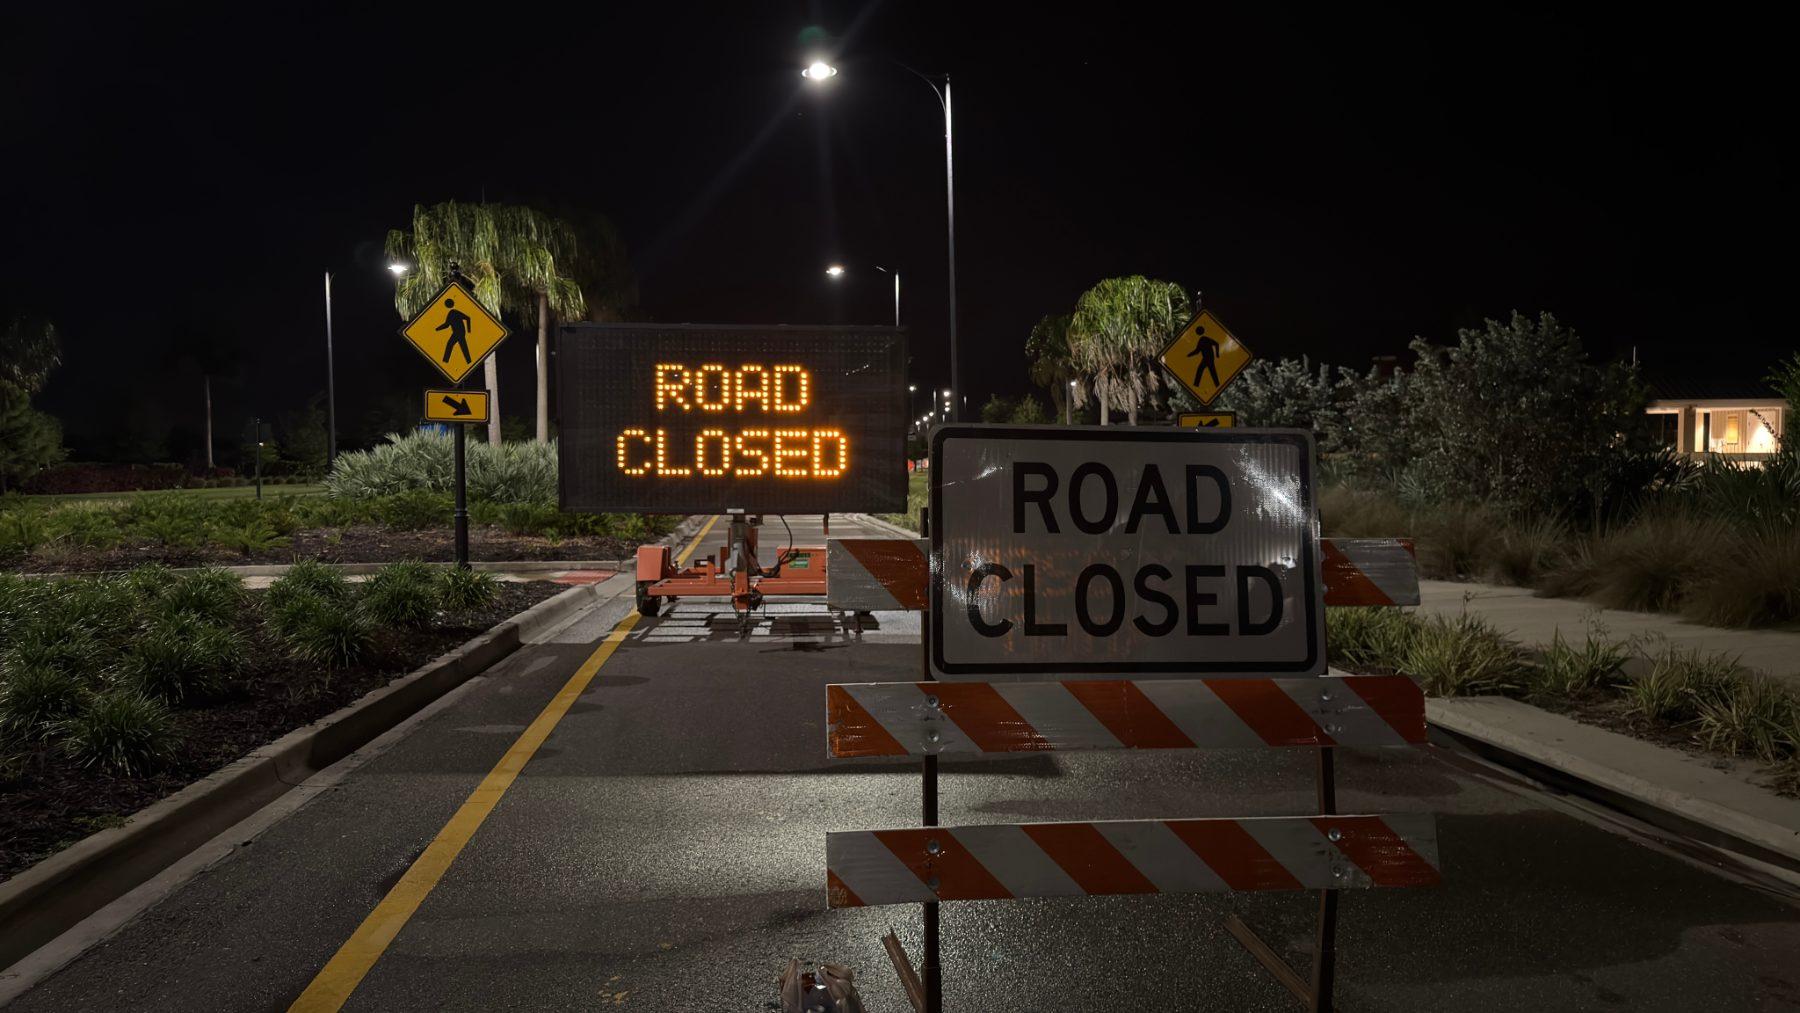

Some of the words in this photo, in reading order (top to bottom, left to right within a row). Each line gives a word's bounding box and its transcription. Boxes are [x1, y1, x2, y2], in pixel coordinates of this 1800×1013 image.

[655, 363, 809, 412] ROAD
[616, 428, 847, 478] CLOSED
[1012, 461, 1232, 535] ROAD
[967, 563, 1284, 638] CLOSED
